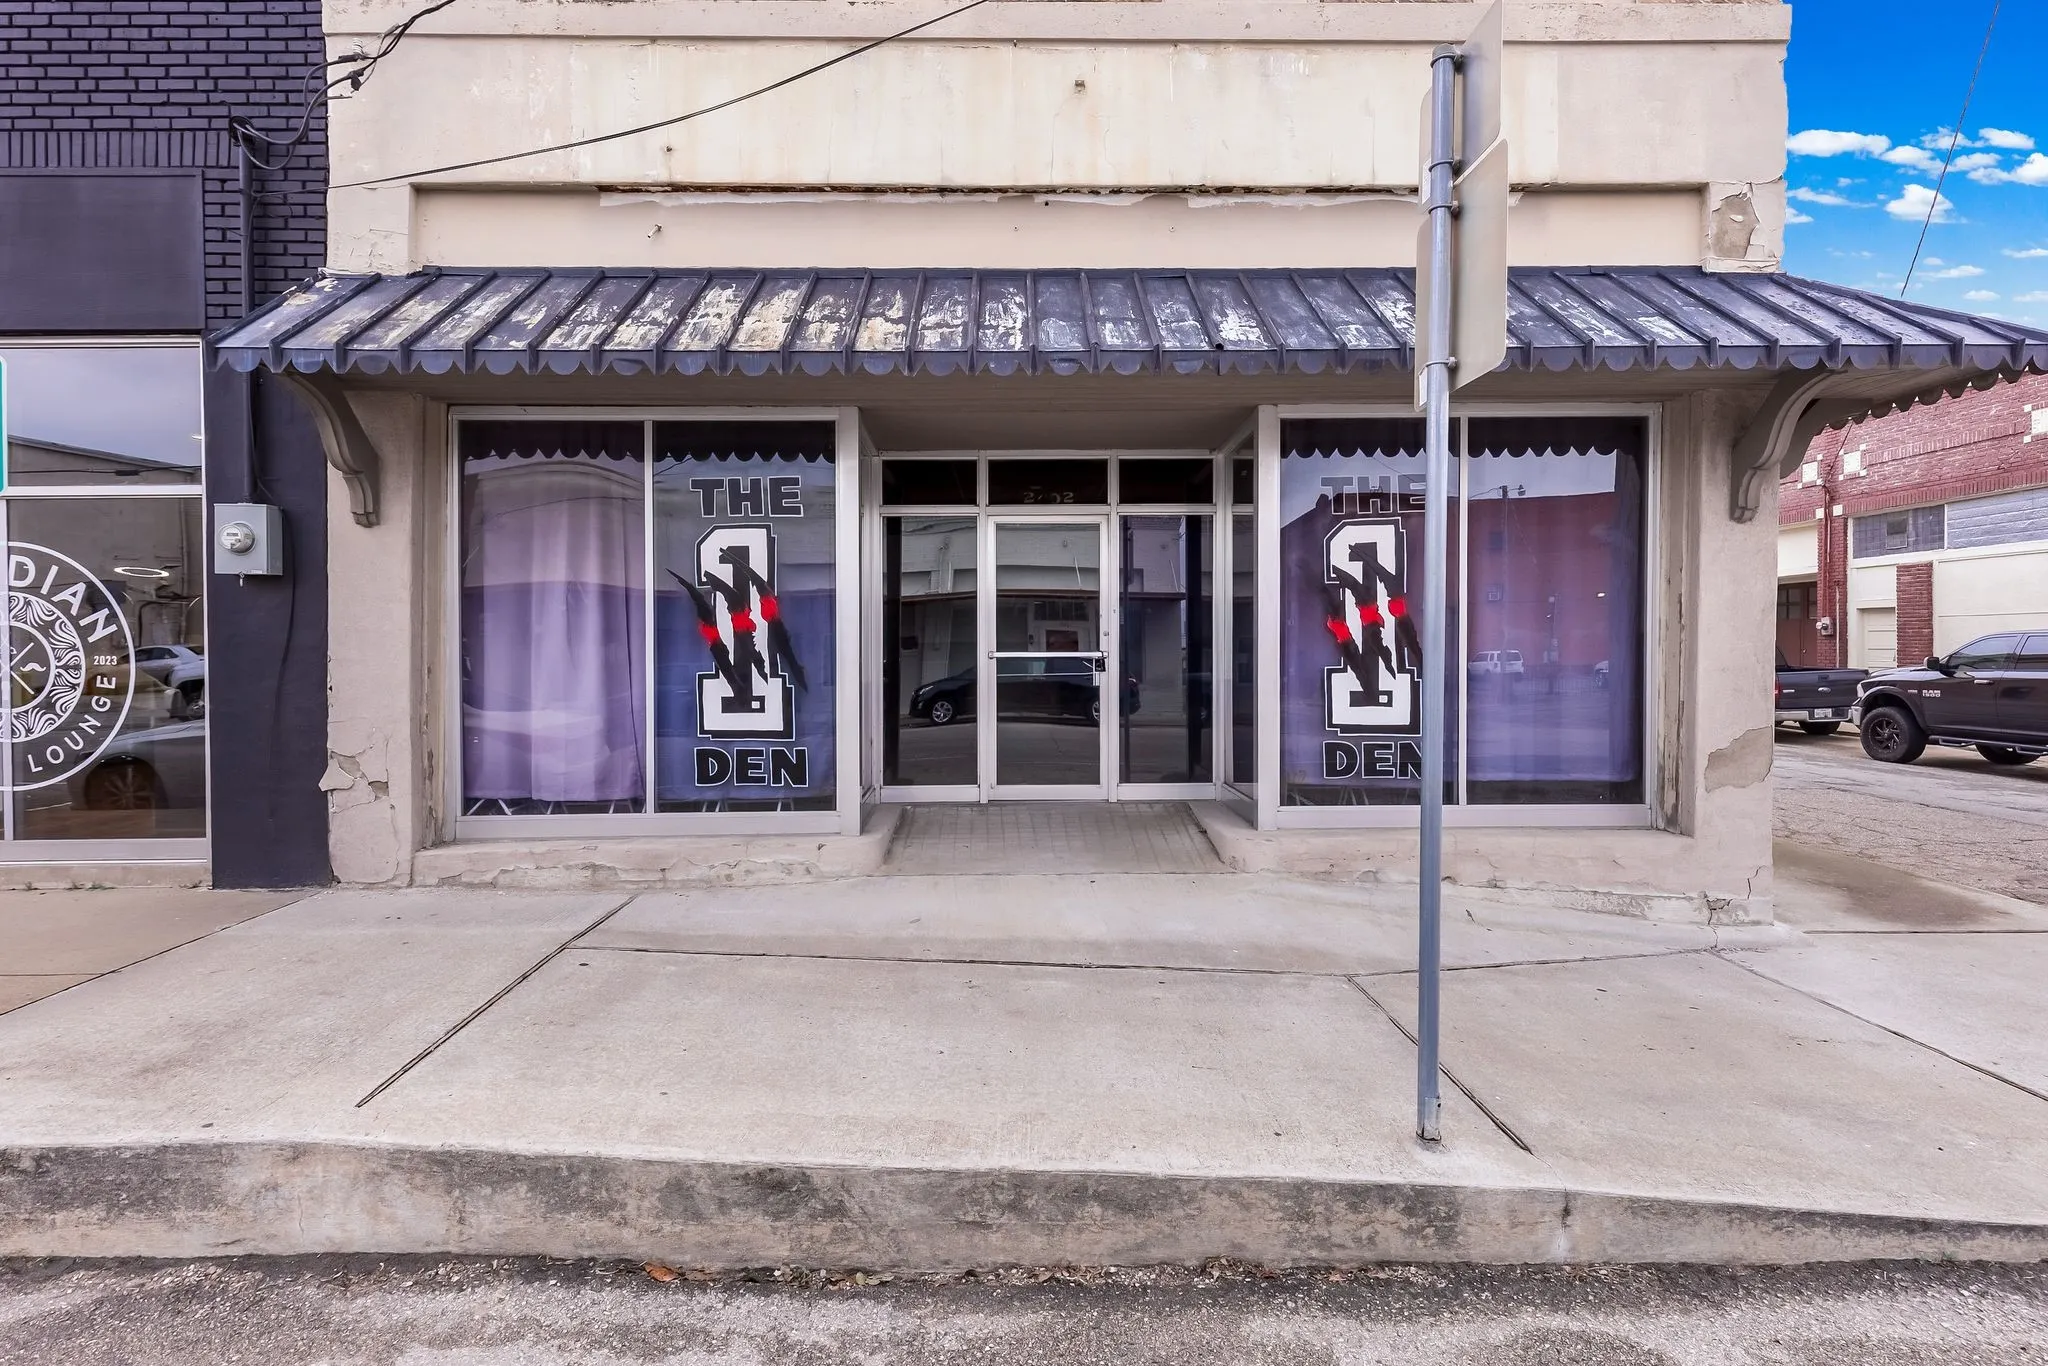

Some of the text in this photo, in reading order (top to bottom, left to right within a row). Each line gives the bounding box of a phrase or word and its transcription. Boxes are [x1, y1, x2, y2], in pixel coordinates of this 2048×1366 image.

[689, 475, 804, 518] THE
[1320, 474, 1427, 515] THE
[93, 655, 118, 666] 2023
[27, 675, 117, 773] LOUNGE
[694, 747, 809, 787] DEN
[1322, 740, 1422, 780] DEN
